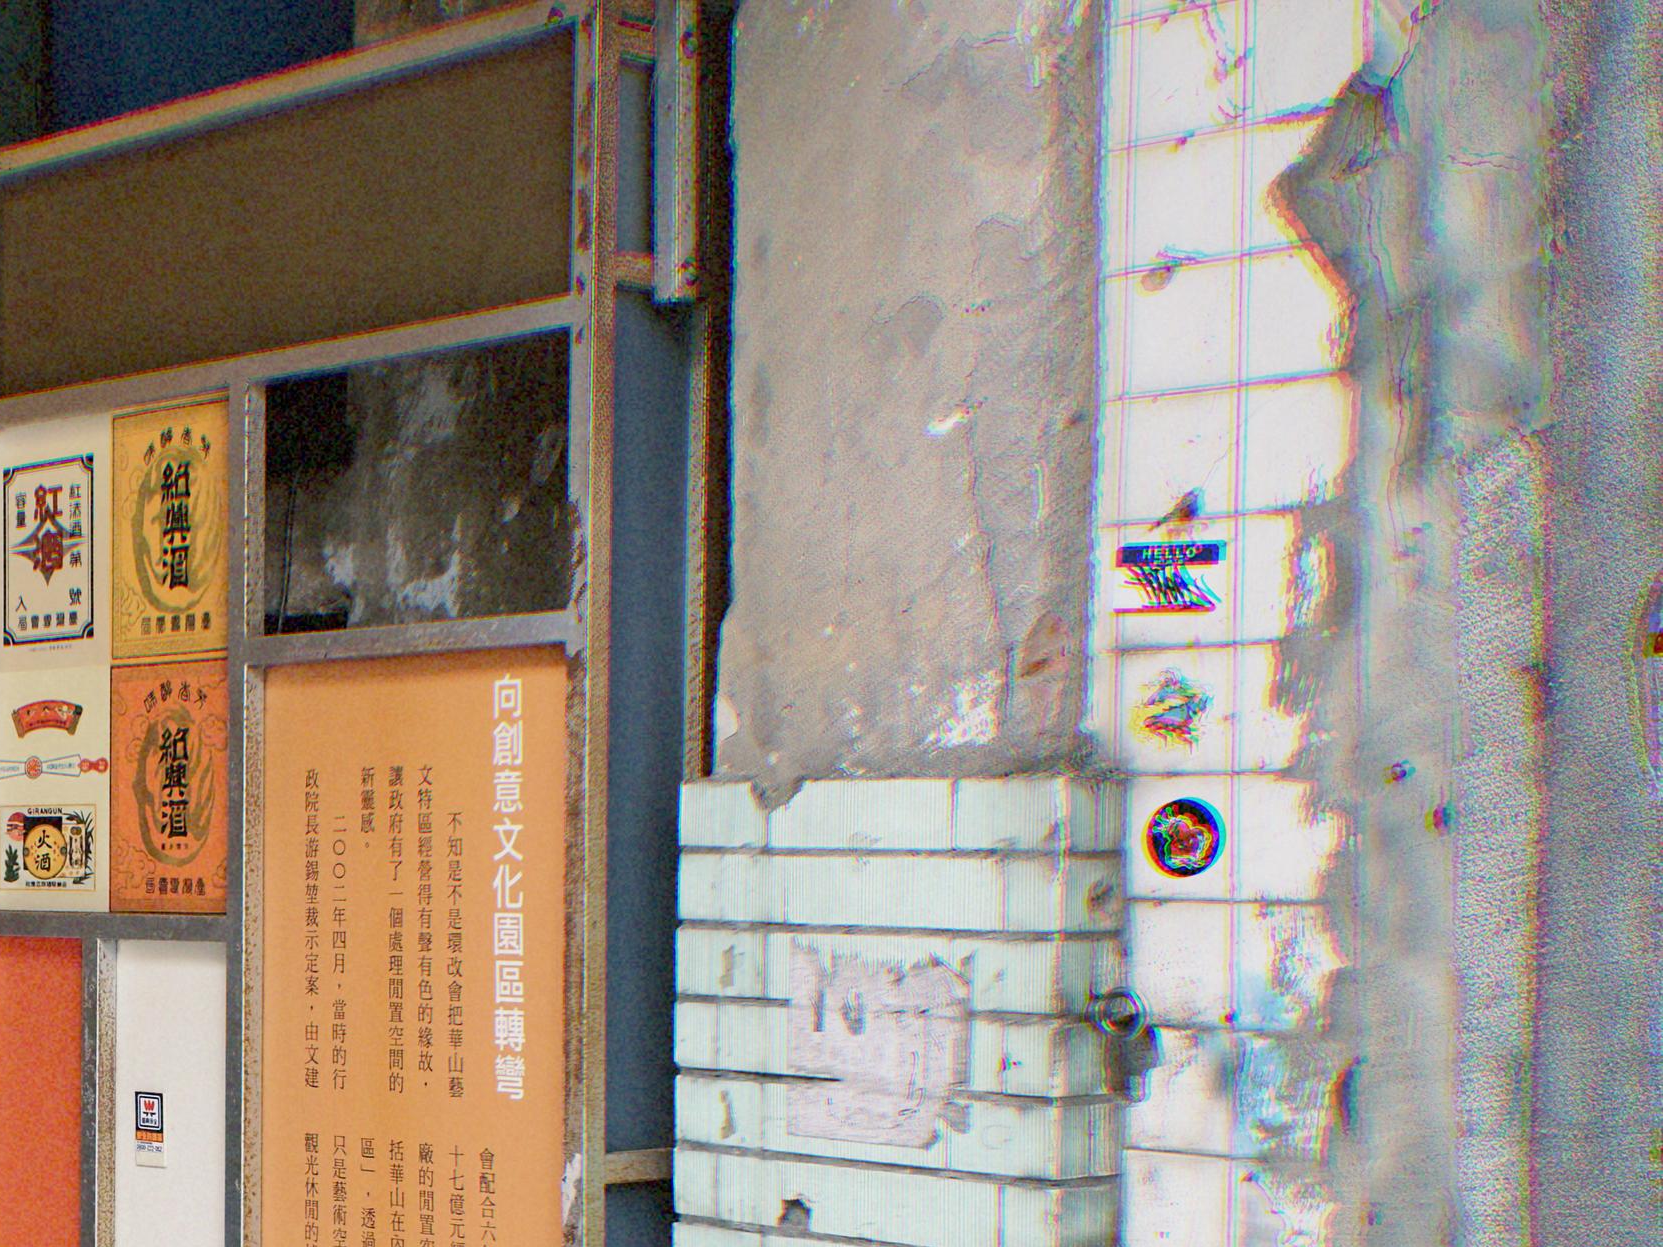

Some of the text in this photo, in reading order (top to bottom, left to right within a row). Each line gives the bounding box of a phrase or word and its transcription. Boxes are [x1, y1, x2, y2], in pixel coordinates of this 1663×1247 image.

[161, 461, 191, 590] 紹興酒
[1141, 545, 1198, 561] HELLO
[159, 726, 189, 839] 紹興酒
[493, 673, 526, 1099] 向創意文化園區轉彎
